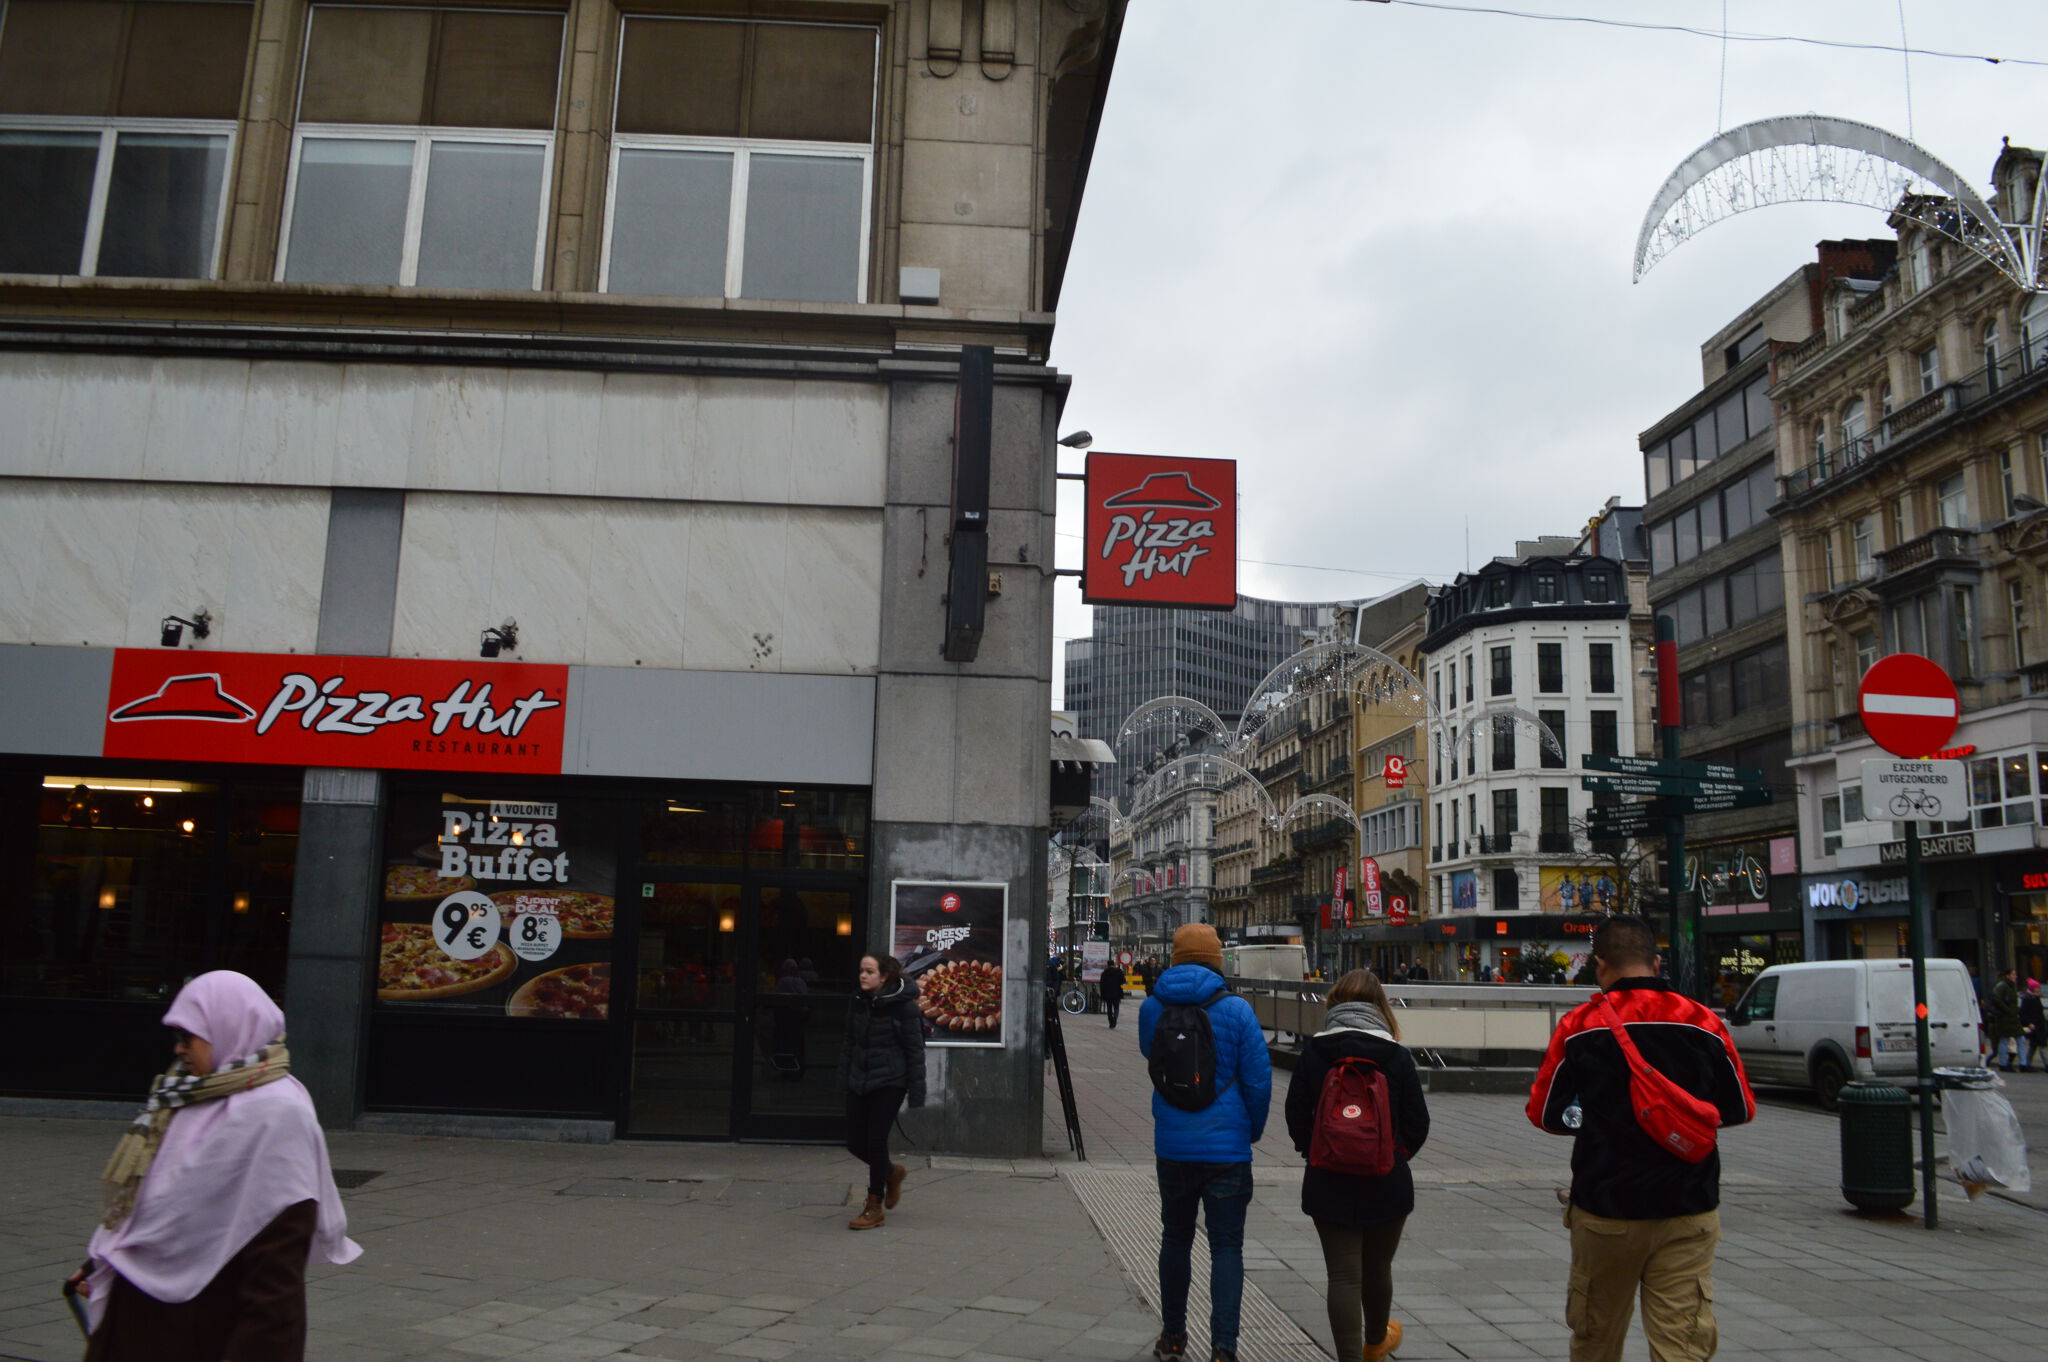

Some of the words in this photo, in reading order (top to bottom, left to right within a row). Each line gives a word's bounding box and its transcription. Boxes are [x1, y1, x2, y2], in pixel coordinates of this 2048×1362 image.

[1102, 509, 1216, 559] Pizza
[1120, 543, 1211, 587] Hut
[255, 672, 425, 735] Pizza
[430, 678, 561, 737] Hut
[412, 739, 542, 757] RESTAURANT
[1389, 757, 1403, 774] Q
[1893, 763, 1934, 773] EXCEPTE
[1879, 774, 1948, 785] UITGEZONDERD
[440, 810, 559, 848] Pizza
[1920, 834, 1973, 857] BARTIER
[437, 844, 570, 883] Buffet
[516, 896, 561, 906] STUDENT
[1809, 882, 1842, 907] WOK
[1859, 877, 1909, 905] SUSHI
[1392, 898, 1405, 913] Q
[442, 902, 469, 945] 9
[466, 926, 487, 949] €
[522, 916, 538, 942] 8
[537, 931, 548, 942] €
[926, 927, 971, 943] CHEESE
[937, 938, 955, 951] DIP
